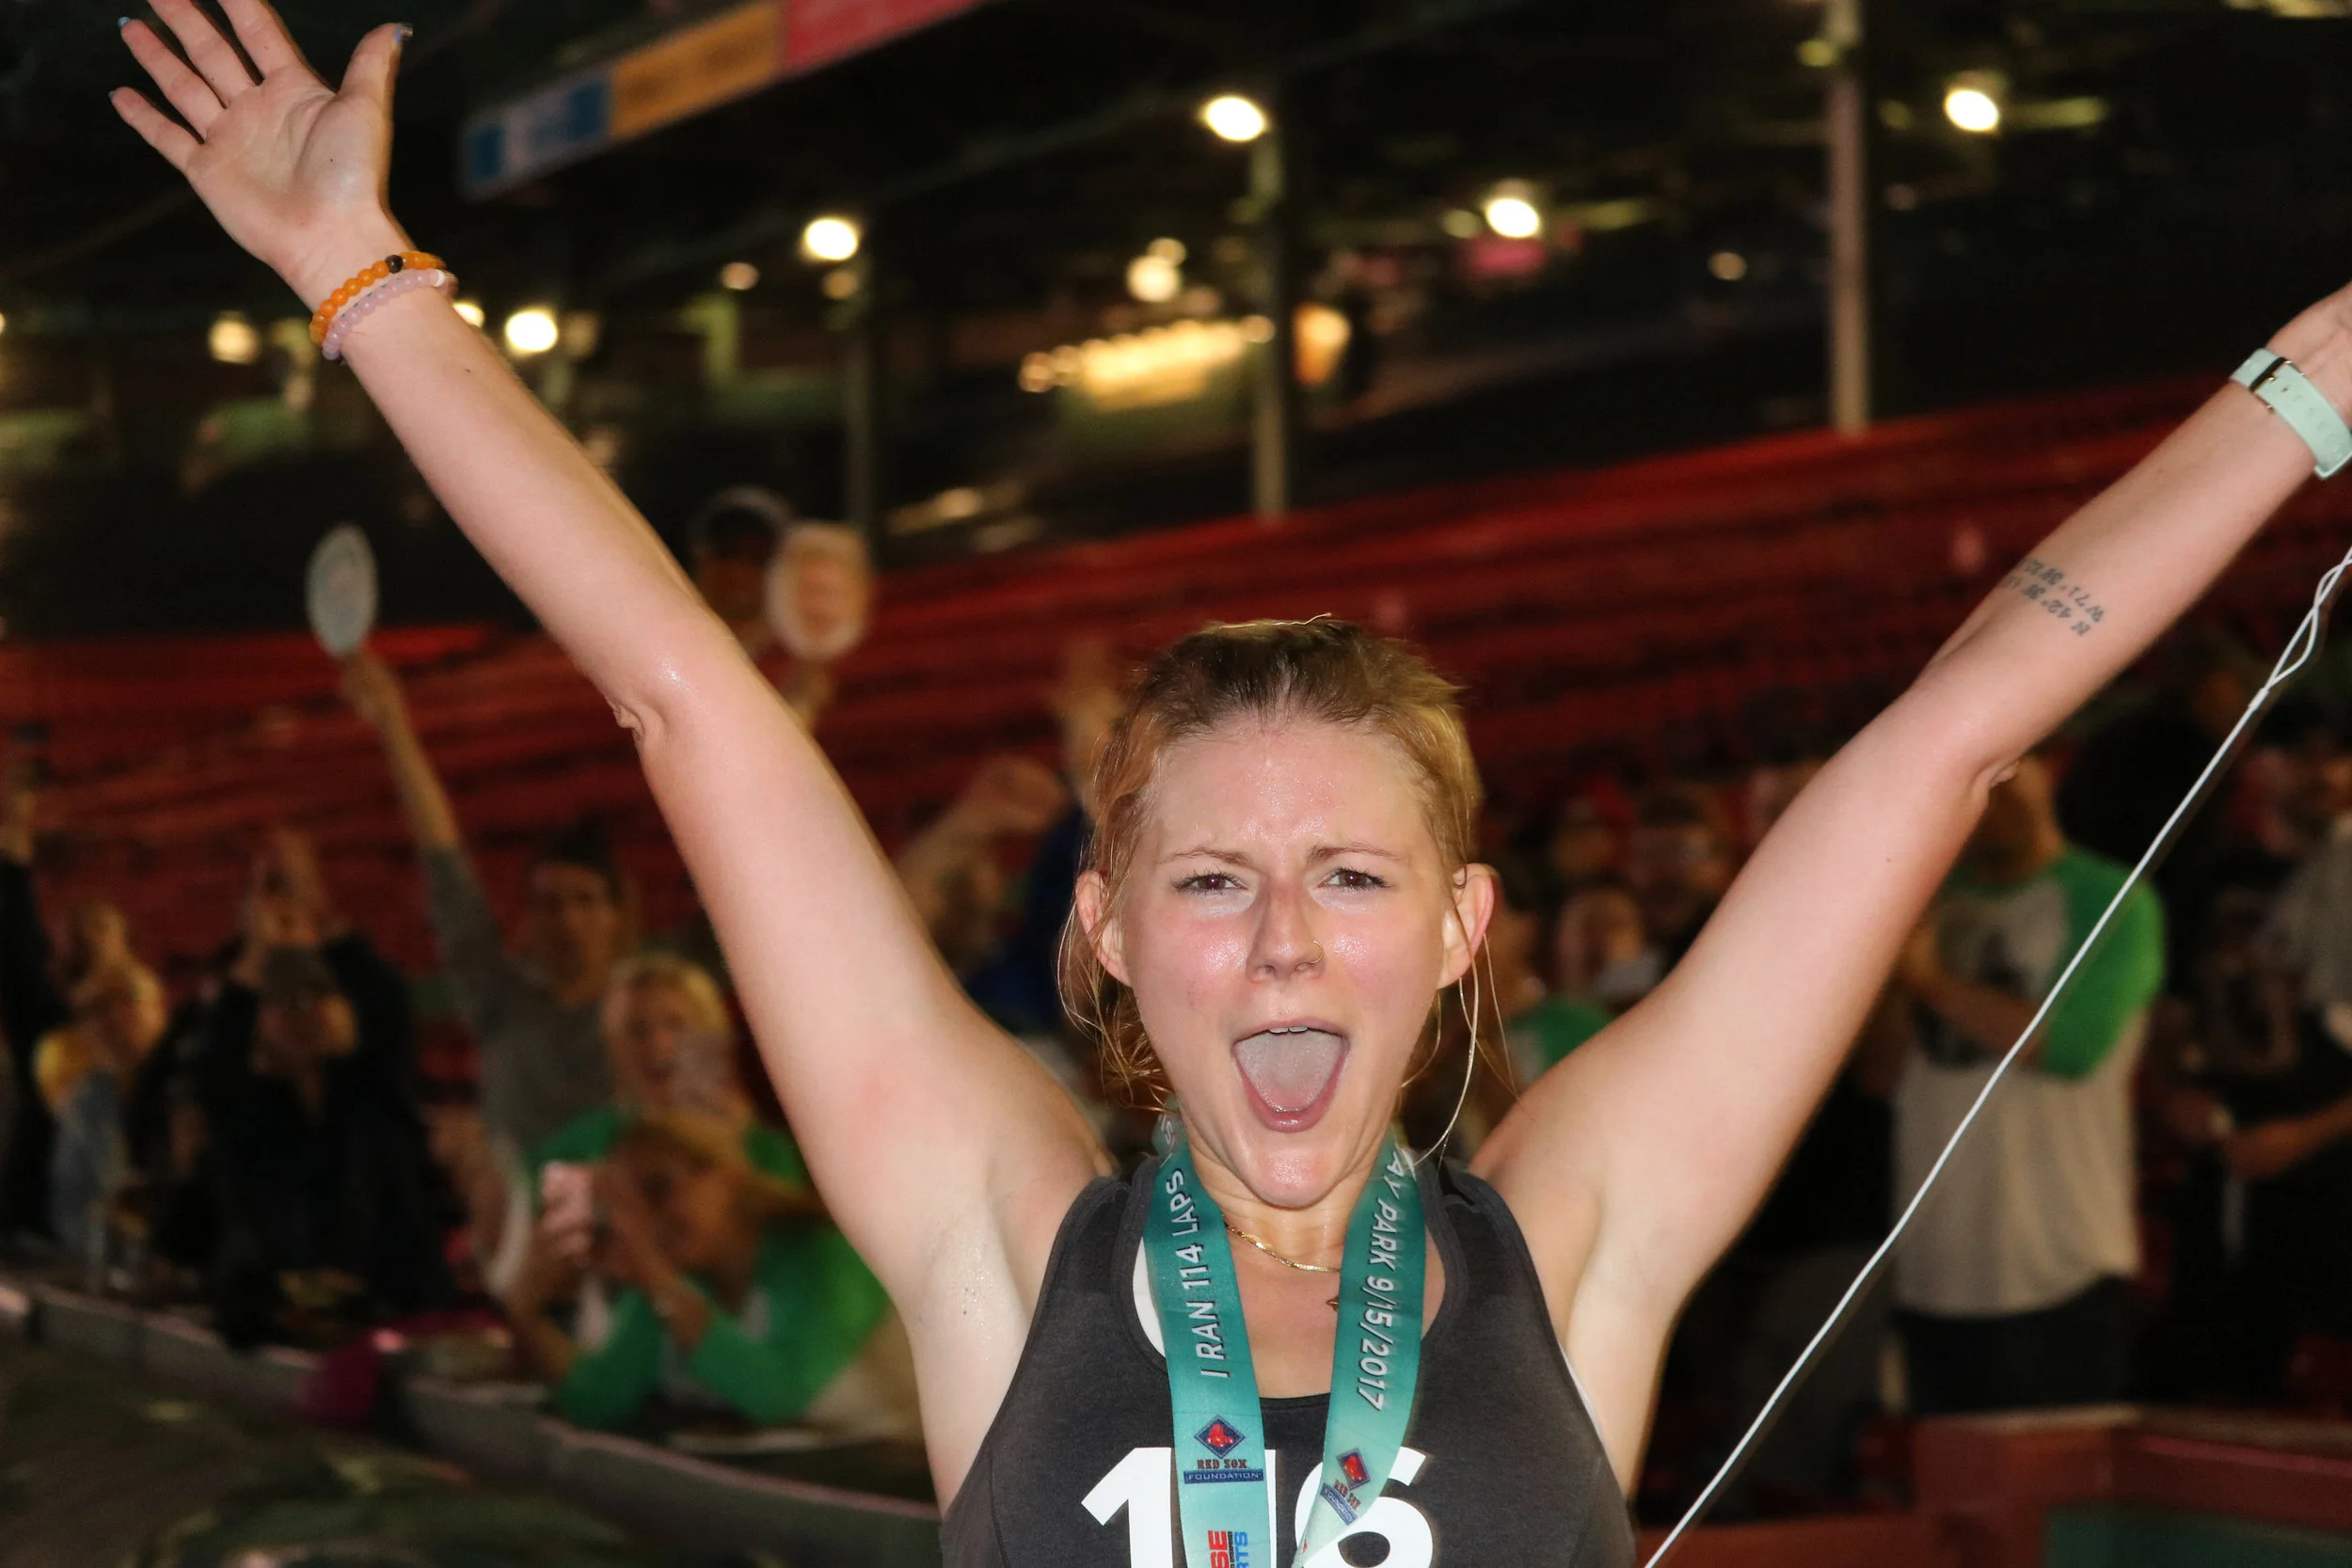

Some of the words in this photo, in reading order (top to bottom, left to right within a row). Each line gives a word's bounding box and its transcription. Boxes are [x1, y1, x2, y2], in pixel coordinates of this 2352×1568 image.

[1166, 1167, 1200, 1237] LAPS
[1369, 1197, 1397, 1271] PARK
[1176, 1243, 1212, 1290] 114
[1185, 1301, 1227, 1361] RAN
[1358, 1275, 1397, 1411] 9/15/2017
[1200, 1369, 1231, 1378] I
[1187, 1472, 1260, 1481] FOUNDATION
[1197, 1459, 1220, 1469] RED
[1224, 1459, 1248, 1469] SOX
